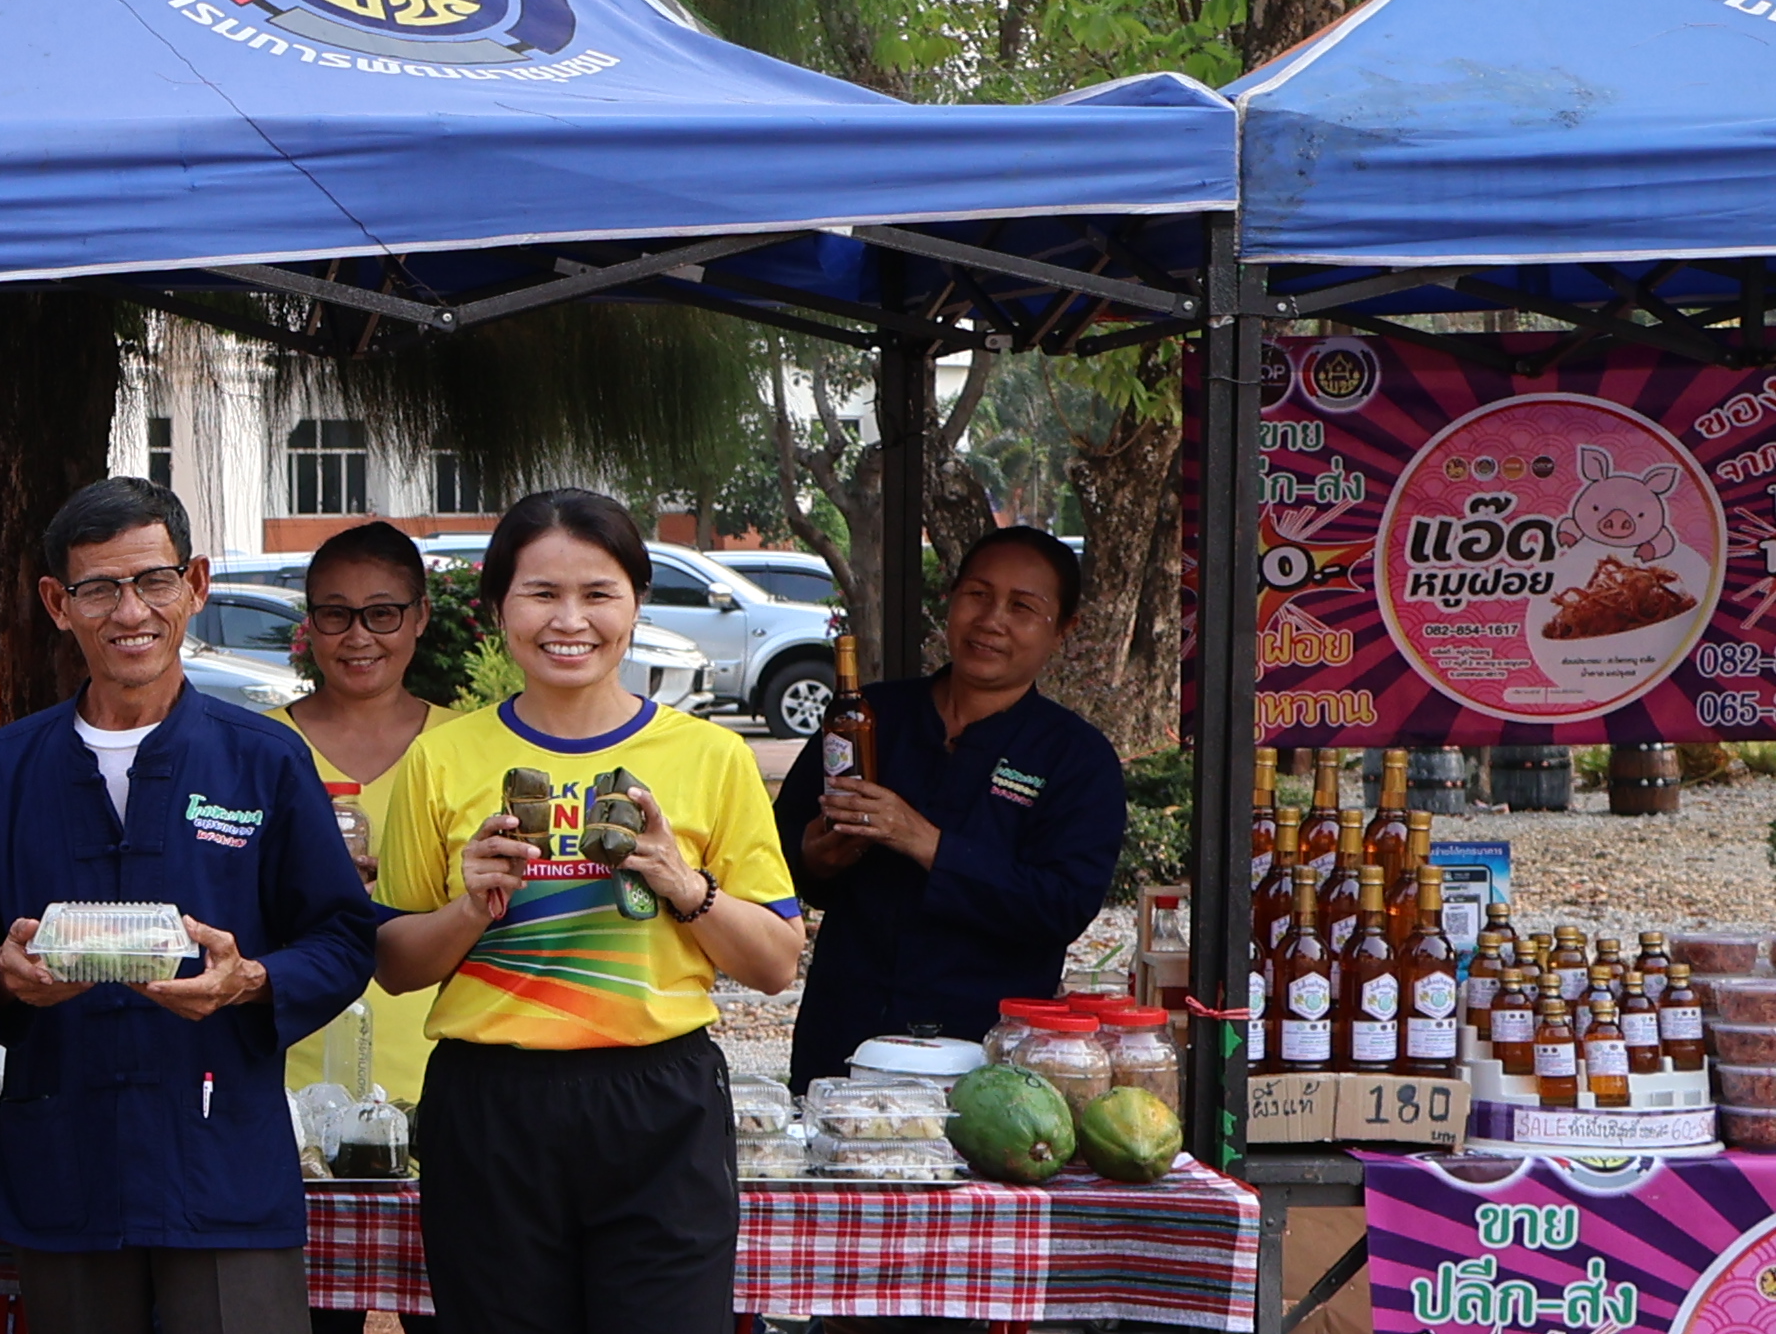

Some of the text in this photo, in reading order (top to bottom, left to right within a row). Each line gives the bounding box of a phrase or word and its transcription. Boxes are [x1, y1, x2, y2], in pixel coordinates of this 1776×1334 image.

[1410, 496, 1556, 565] แอ๊ด
[1408, 566, 1555, 608] หมูฝอย
[1365, 1083, 1452, 1124] 180
[1517, 1116, 1568, 1137] SALE
[1479, 1205, 1578, 1247] ขาย
[1414, 1259, 1636, 1325] ปลีก-ส่ง
